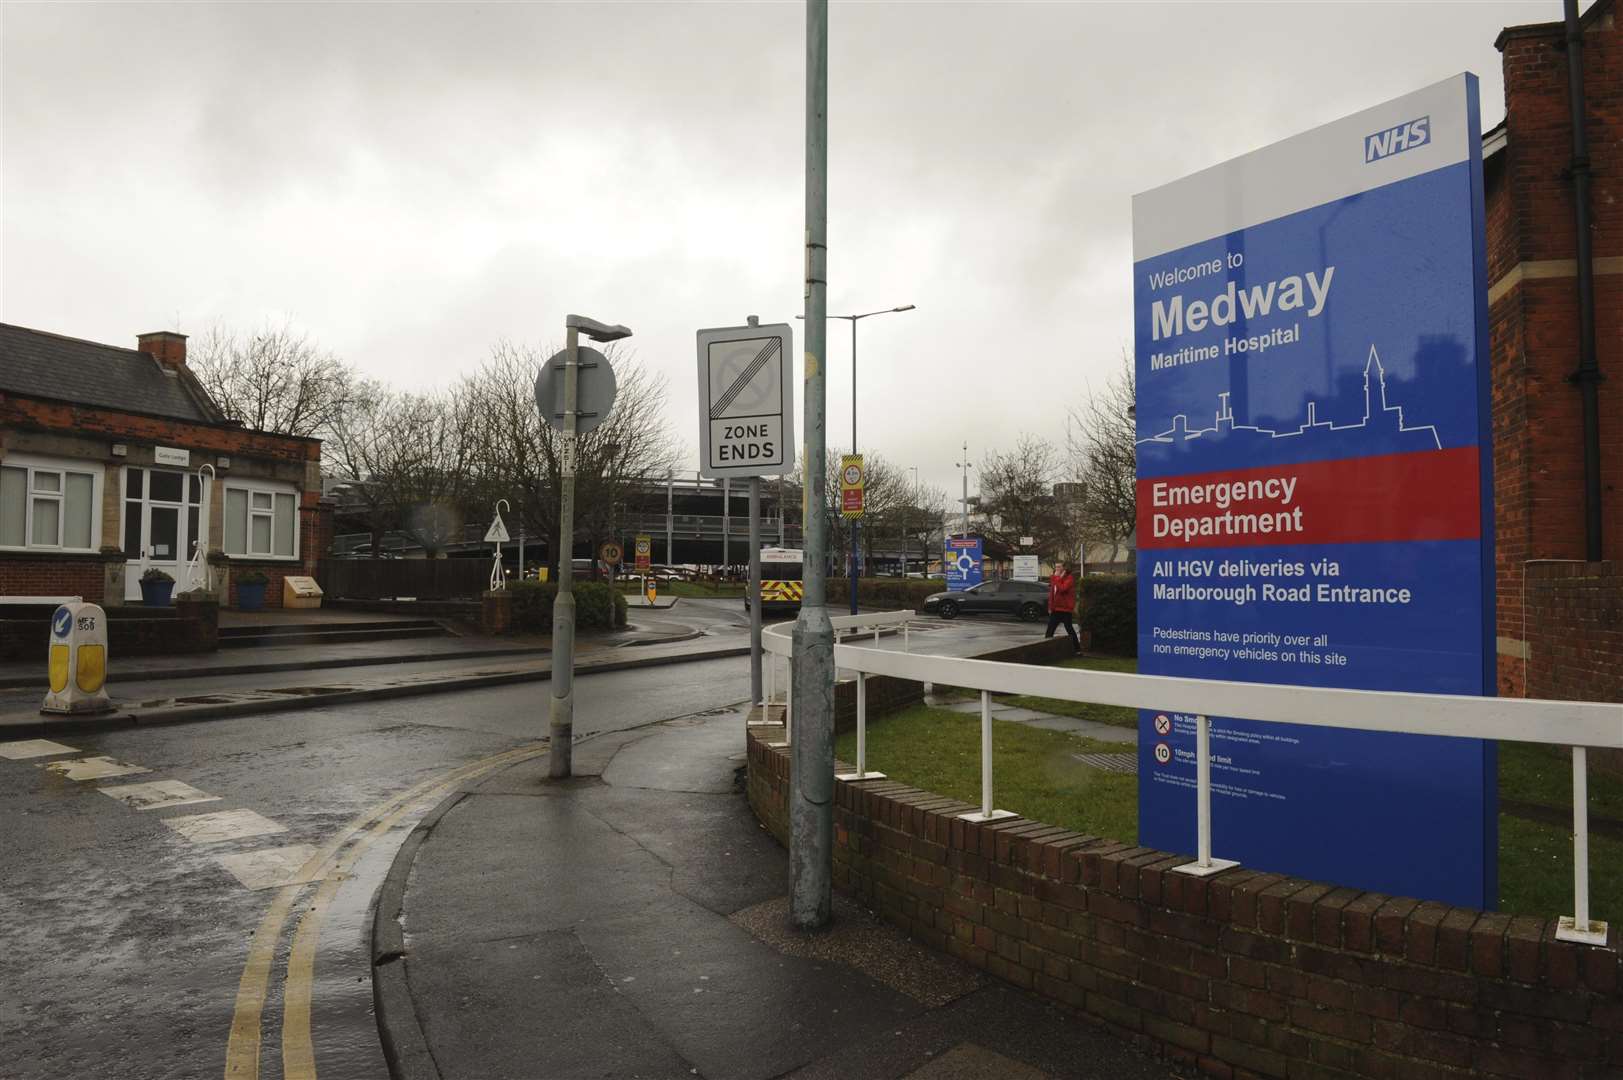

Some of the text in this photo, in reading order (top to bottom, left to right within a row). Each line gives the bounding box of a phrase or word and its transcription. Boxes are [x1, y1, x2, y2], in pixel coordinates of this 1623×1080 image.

[1366, 117, 1429, 161] NHS
[1150, 252, 1243, 290] Welcome to
[1152, 266, 1335, 341] Medway
[1151, 323, 1299, 370] Maritime Hospital
[724, 424, 768, 439] ZONE
[719, 442, 774, 461] ENDS
[1152, 477, 1296, 509] Emergency
[1153, 505, 1303, 542] Department
[606, 547, 618, 558] 10
[1152, 558, 1340, 577] All HGV deliveries via
[1153, 583, 1411, 605] Marlborough Road Entrance
[1153, 626, 1328, 648] Pedestrians have priority over all
[1153, 643, 1347, 666] non emergency vehicles on this site
[1174, 714, 1183, 722] No
[1157, 747, 1168, 759] 10
[1174, 748, 1196, 759] 10mph
[1216, 755, 1232, 765] limit
